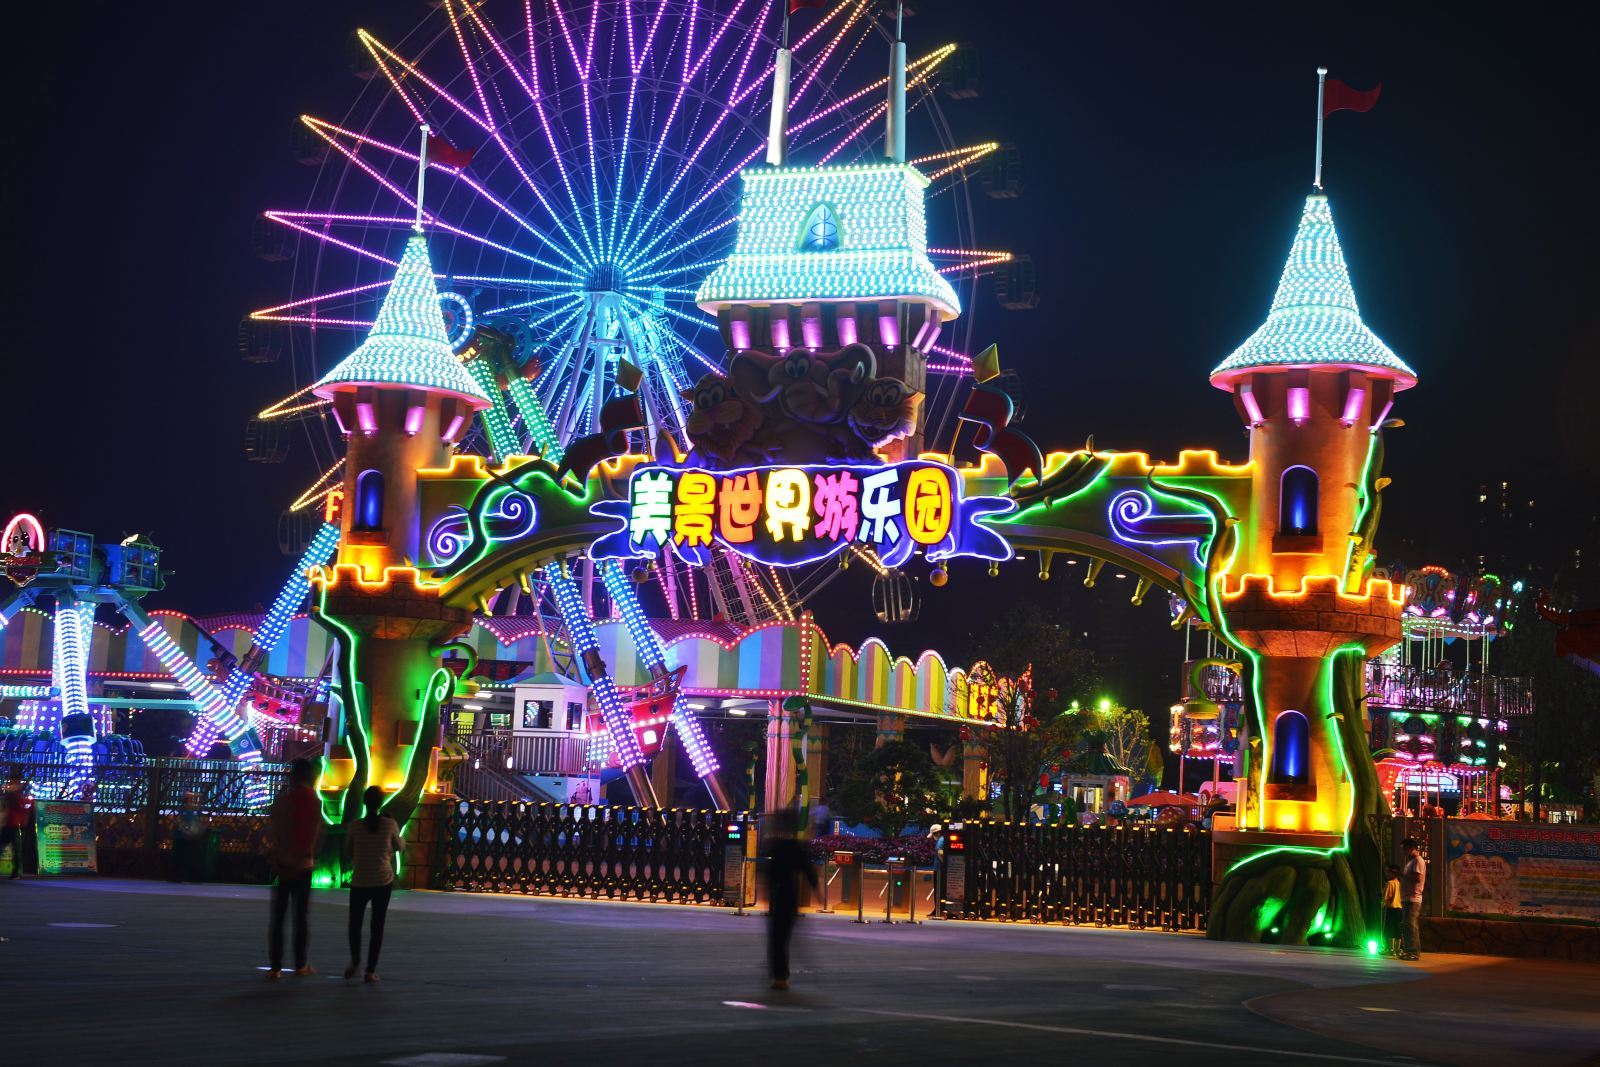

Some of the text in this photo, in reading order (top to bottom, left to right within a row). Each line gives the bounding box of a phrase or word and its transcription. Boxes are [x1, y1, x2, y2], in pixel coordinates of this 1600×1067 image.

[629, 467, 952, 546] 美景世界游乐园
